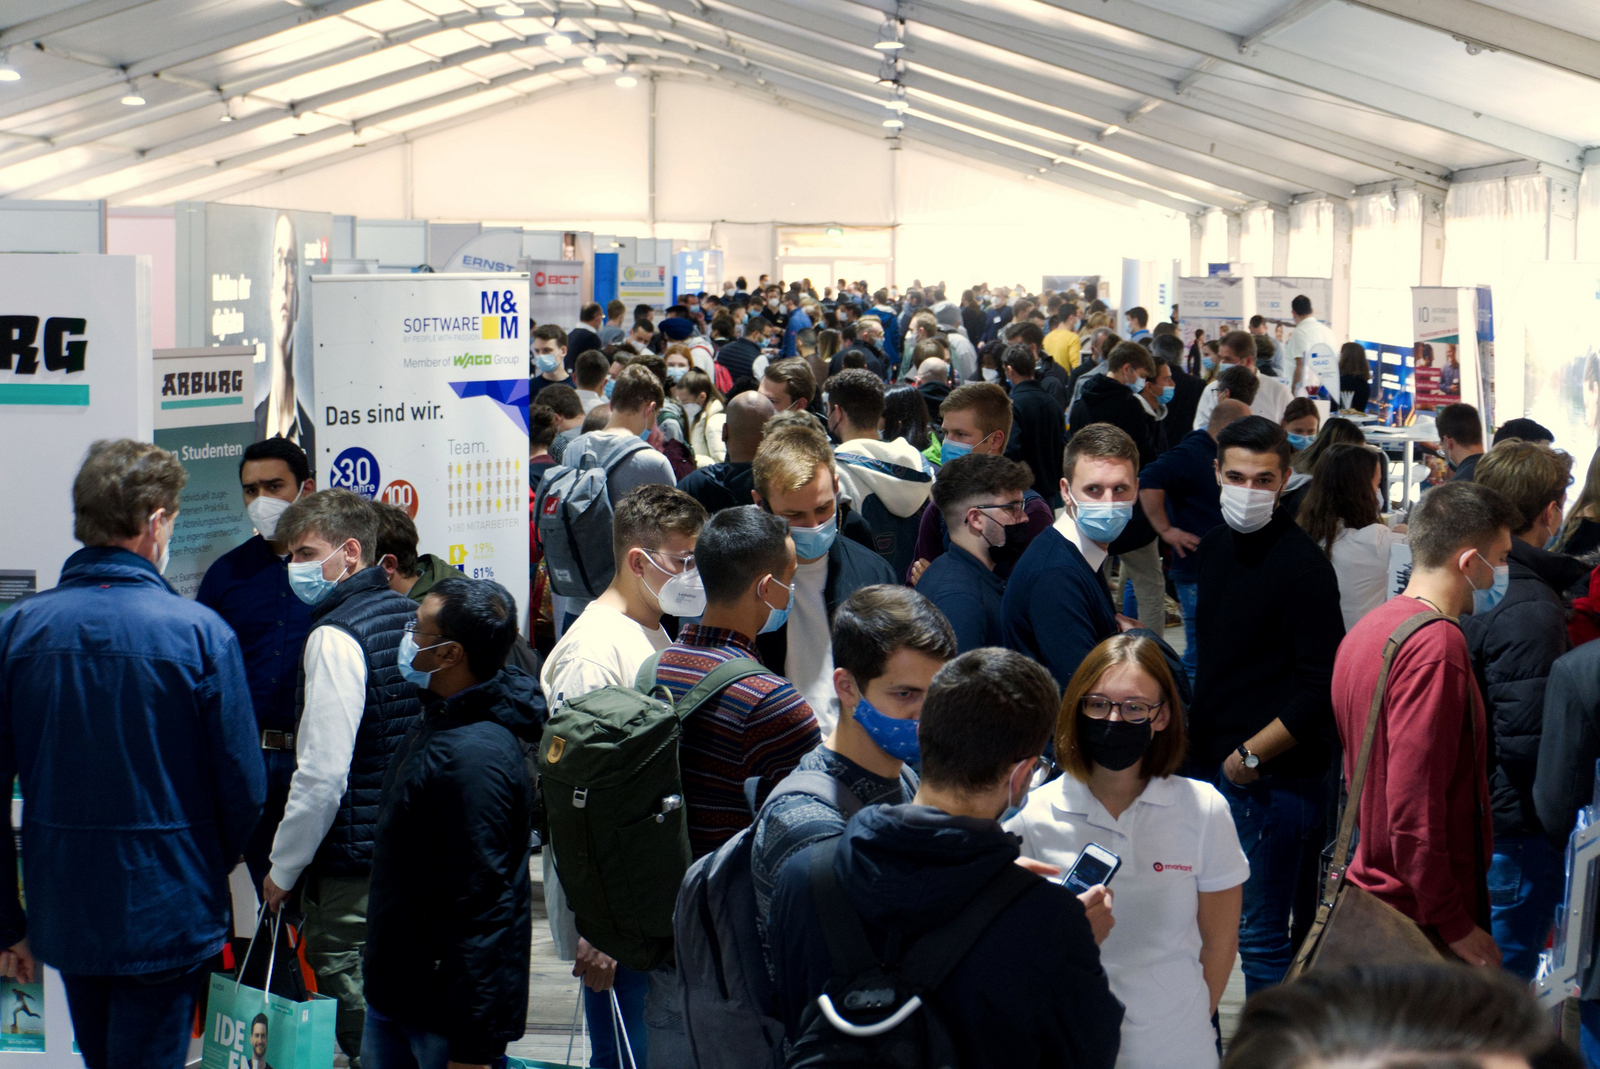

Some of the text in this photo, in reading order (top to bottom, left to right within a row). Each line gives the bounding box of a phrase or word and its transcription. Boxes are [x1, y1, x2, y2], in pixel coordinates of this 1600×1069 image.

[462, 255, 515, 272] ERNST
[548, 275, 579, 285] BCT
[404, 317, 480, 333] SOFTWARE
[453, 333, 480, 341] PASSION
[404, 352, 519, 369] Member of WAGO Group
[162, 370, 243, 396] ARBURG
[326, 400, 444, 426] Das sind wir.
[182, 442, 243, 462] Studenten
[448, 438, 490, 455] Team.
[332, 457, 371, 487] >30
[467, 518, 519, 531] MITARBEITER
[474, 542, 494, 554] 19%
[473, 567, 494, 579] 81%
[214, 1012, 246, 1052] IDE
